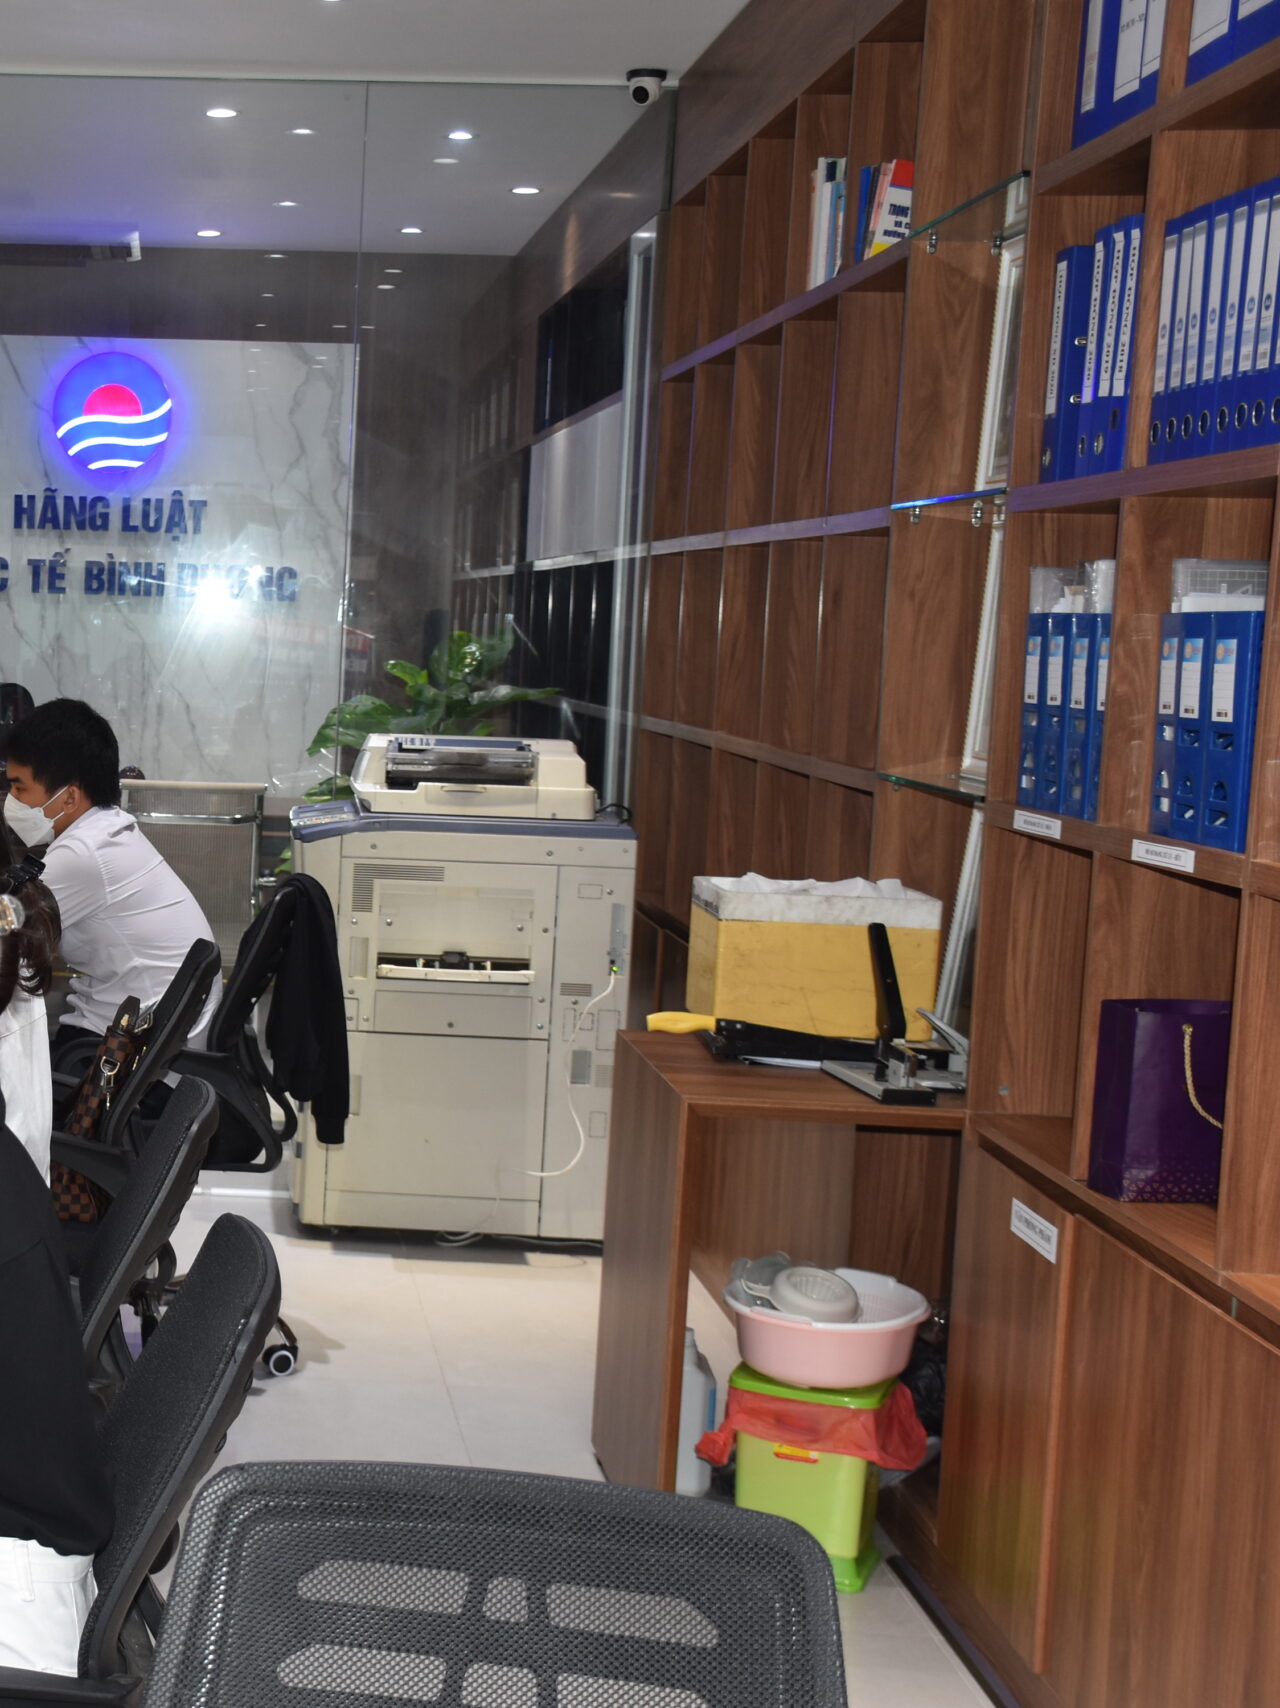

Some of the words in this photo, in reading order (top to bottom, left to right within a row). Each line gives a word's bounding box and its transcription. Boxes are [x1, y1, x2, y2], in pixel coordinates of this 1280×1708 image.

[13, 488, 110, 532] HÃNG
[122, 490, 208, 542] LUẬT
[27, 548, 71, 595] TẾ
[84, 553, 165, 597] BÌNH
